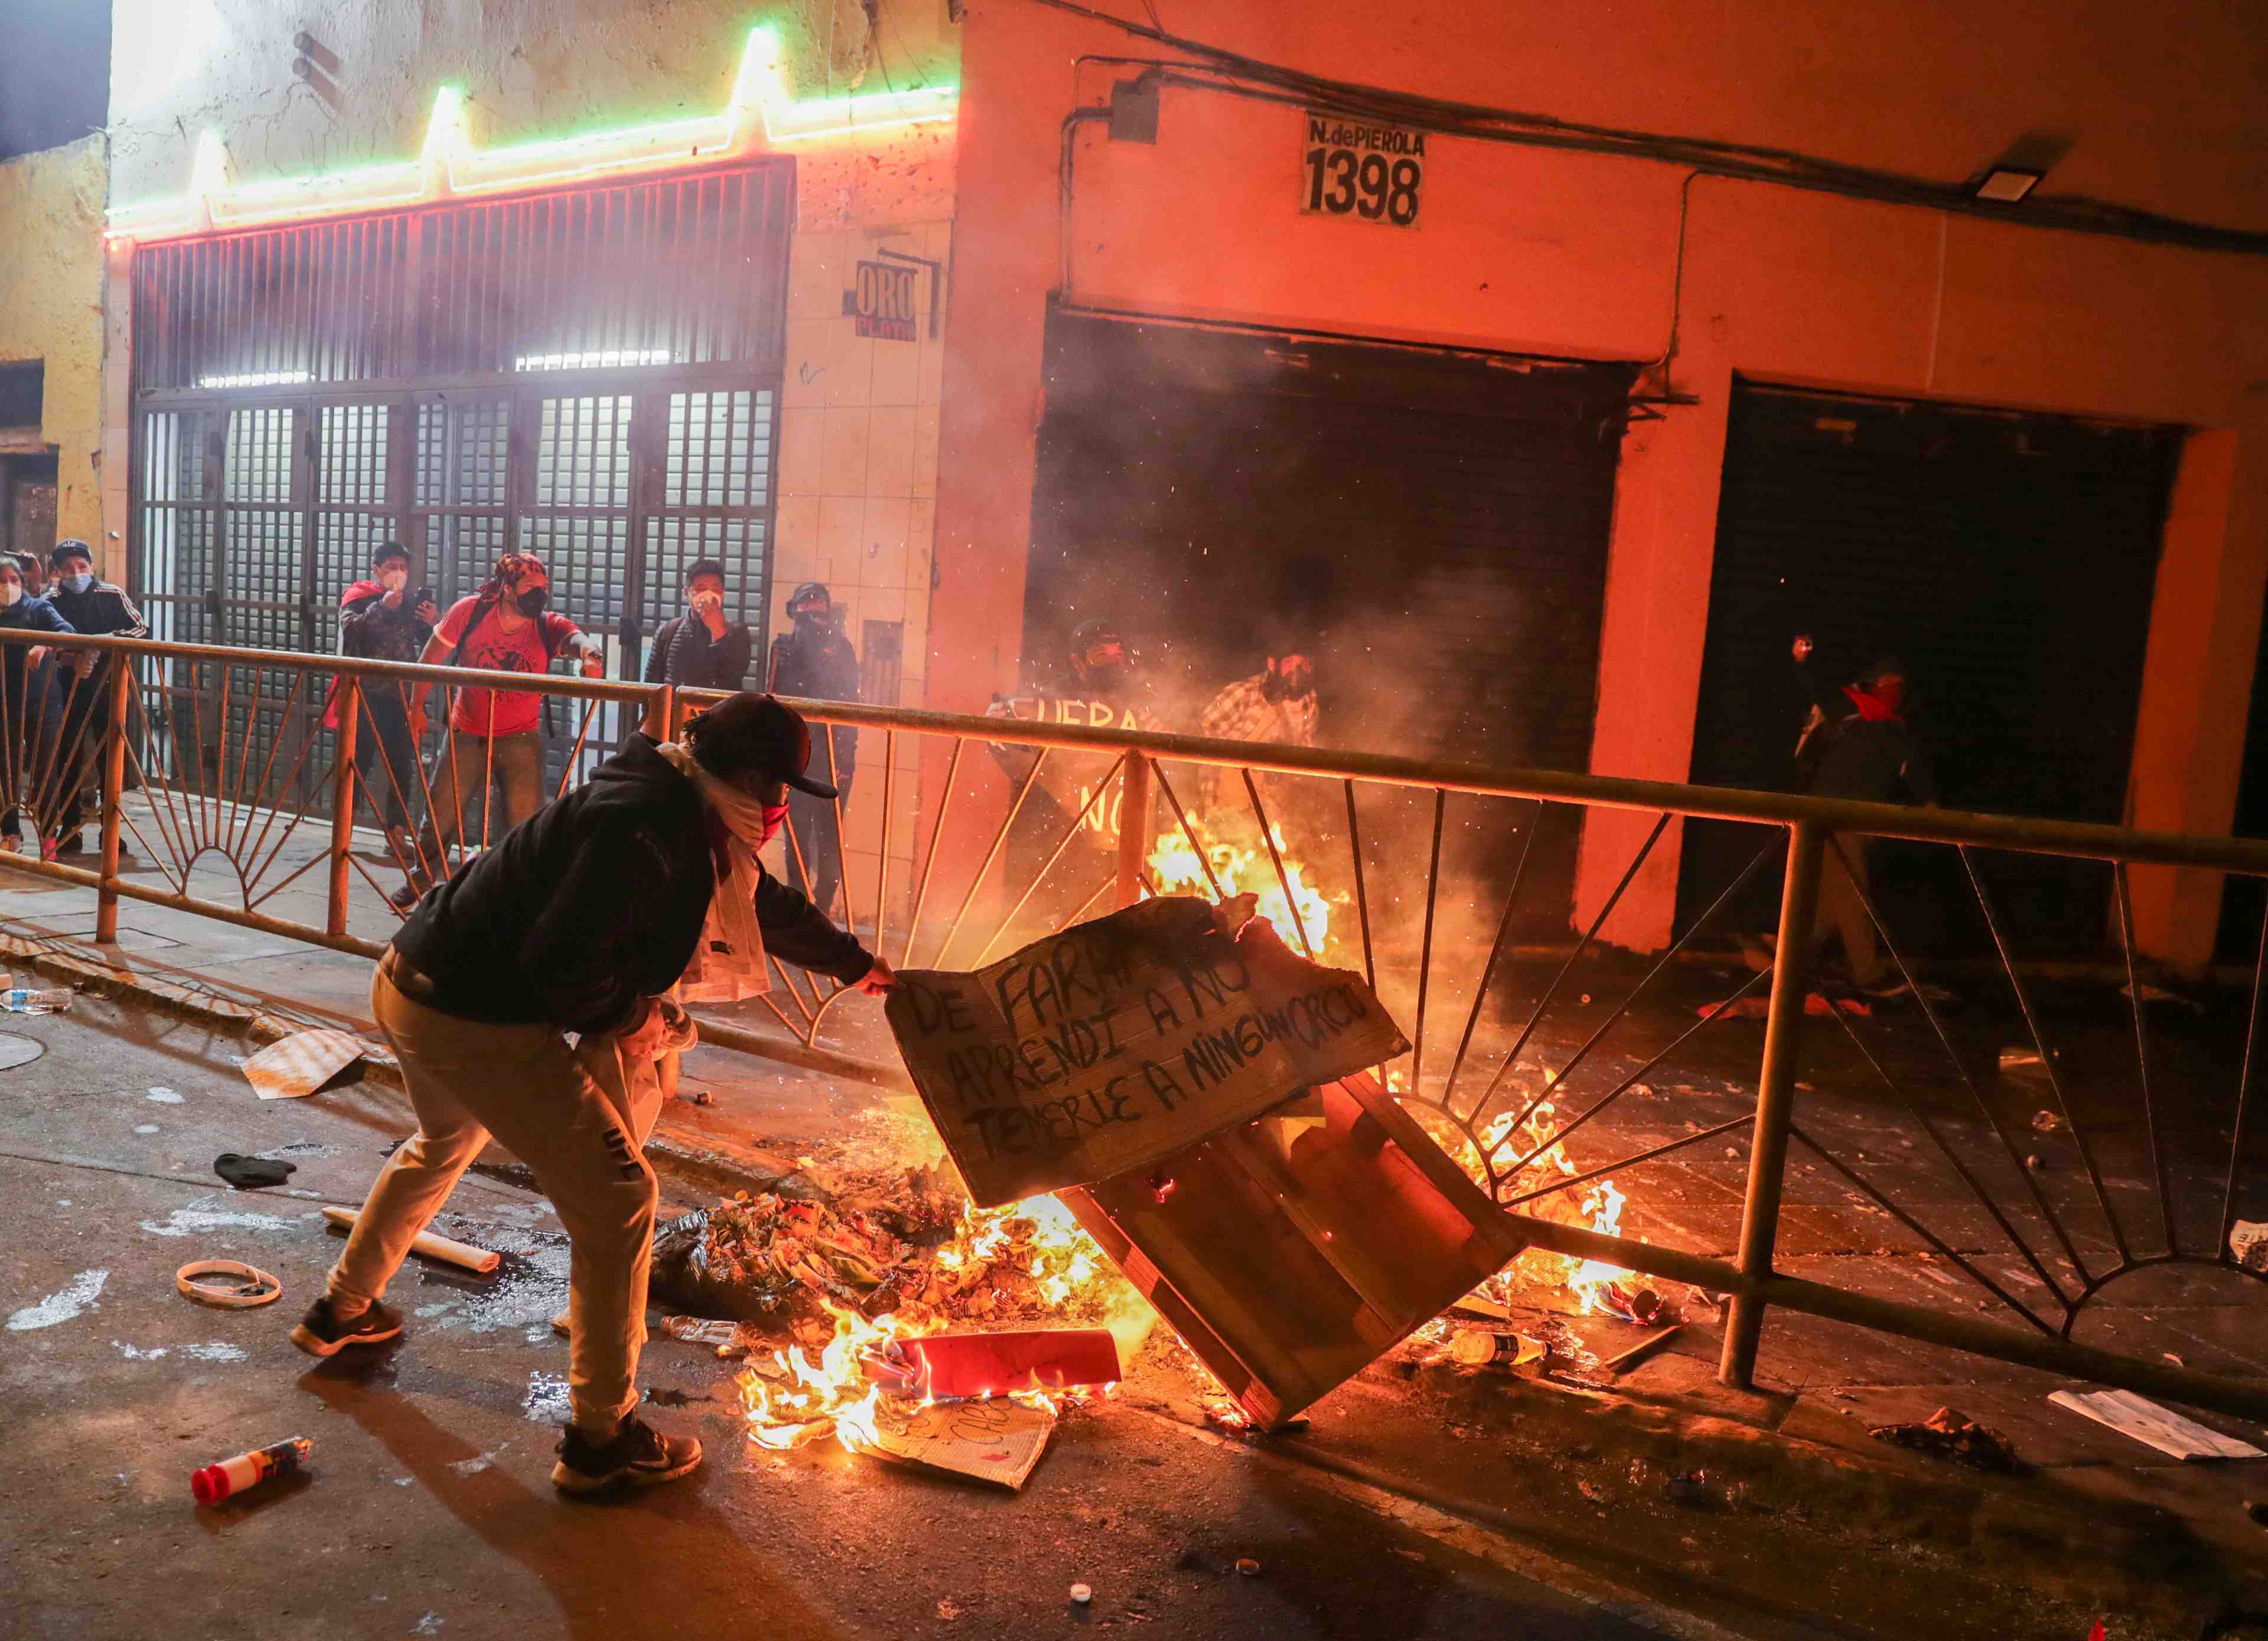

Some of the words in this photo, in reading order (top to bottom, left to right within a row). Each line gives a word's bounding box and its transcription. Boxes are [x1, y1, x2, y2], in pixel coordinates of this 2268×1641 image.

[1306, 148, 1420, 225] 1398
[856, 266, 915, 320] ORO
[906, 982, 977, 1035] DE
[1144, 987, 1182, 1036] A
[1177, 958, 1250, 1018] NO
[1142, 1060, 1188, 1112] A
